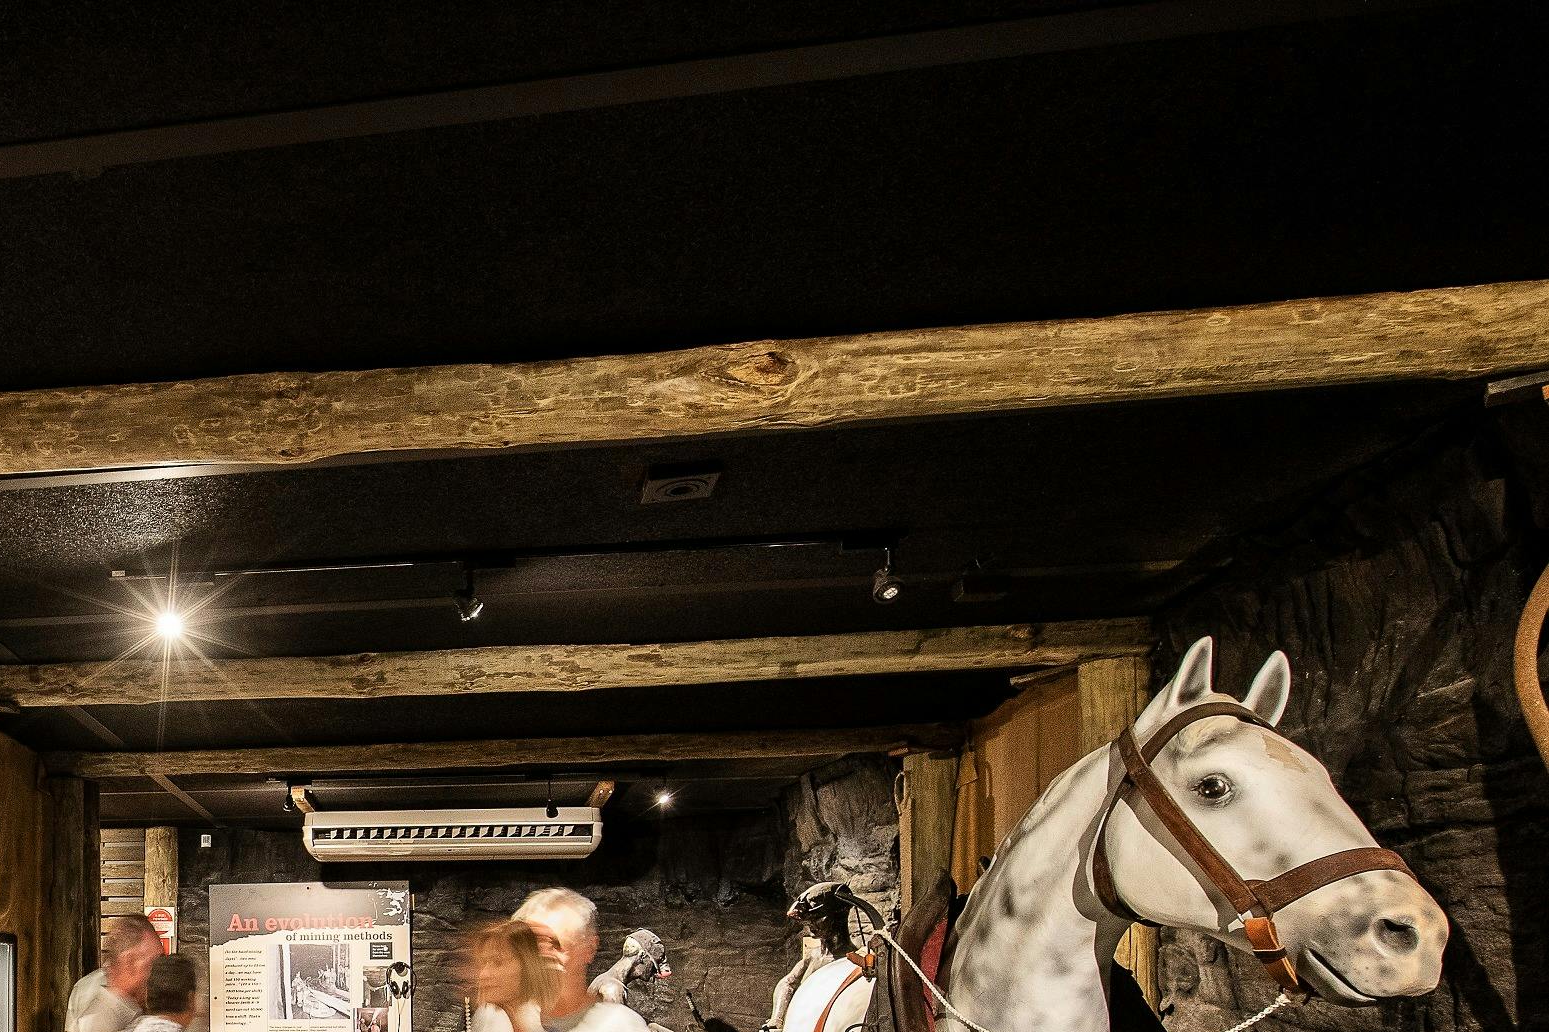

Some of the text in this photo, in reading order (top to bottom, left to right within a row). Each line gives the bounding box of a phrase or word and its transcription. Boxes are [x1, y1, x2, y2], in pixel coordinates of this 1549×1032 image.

[227, 912, 373, 931] An evolution
[285, 931, 392, 943] of mining methods
